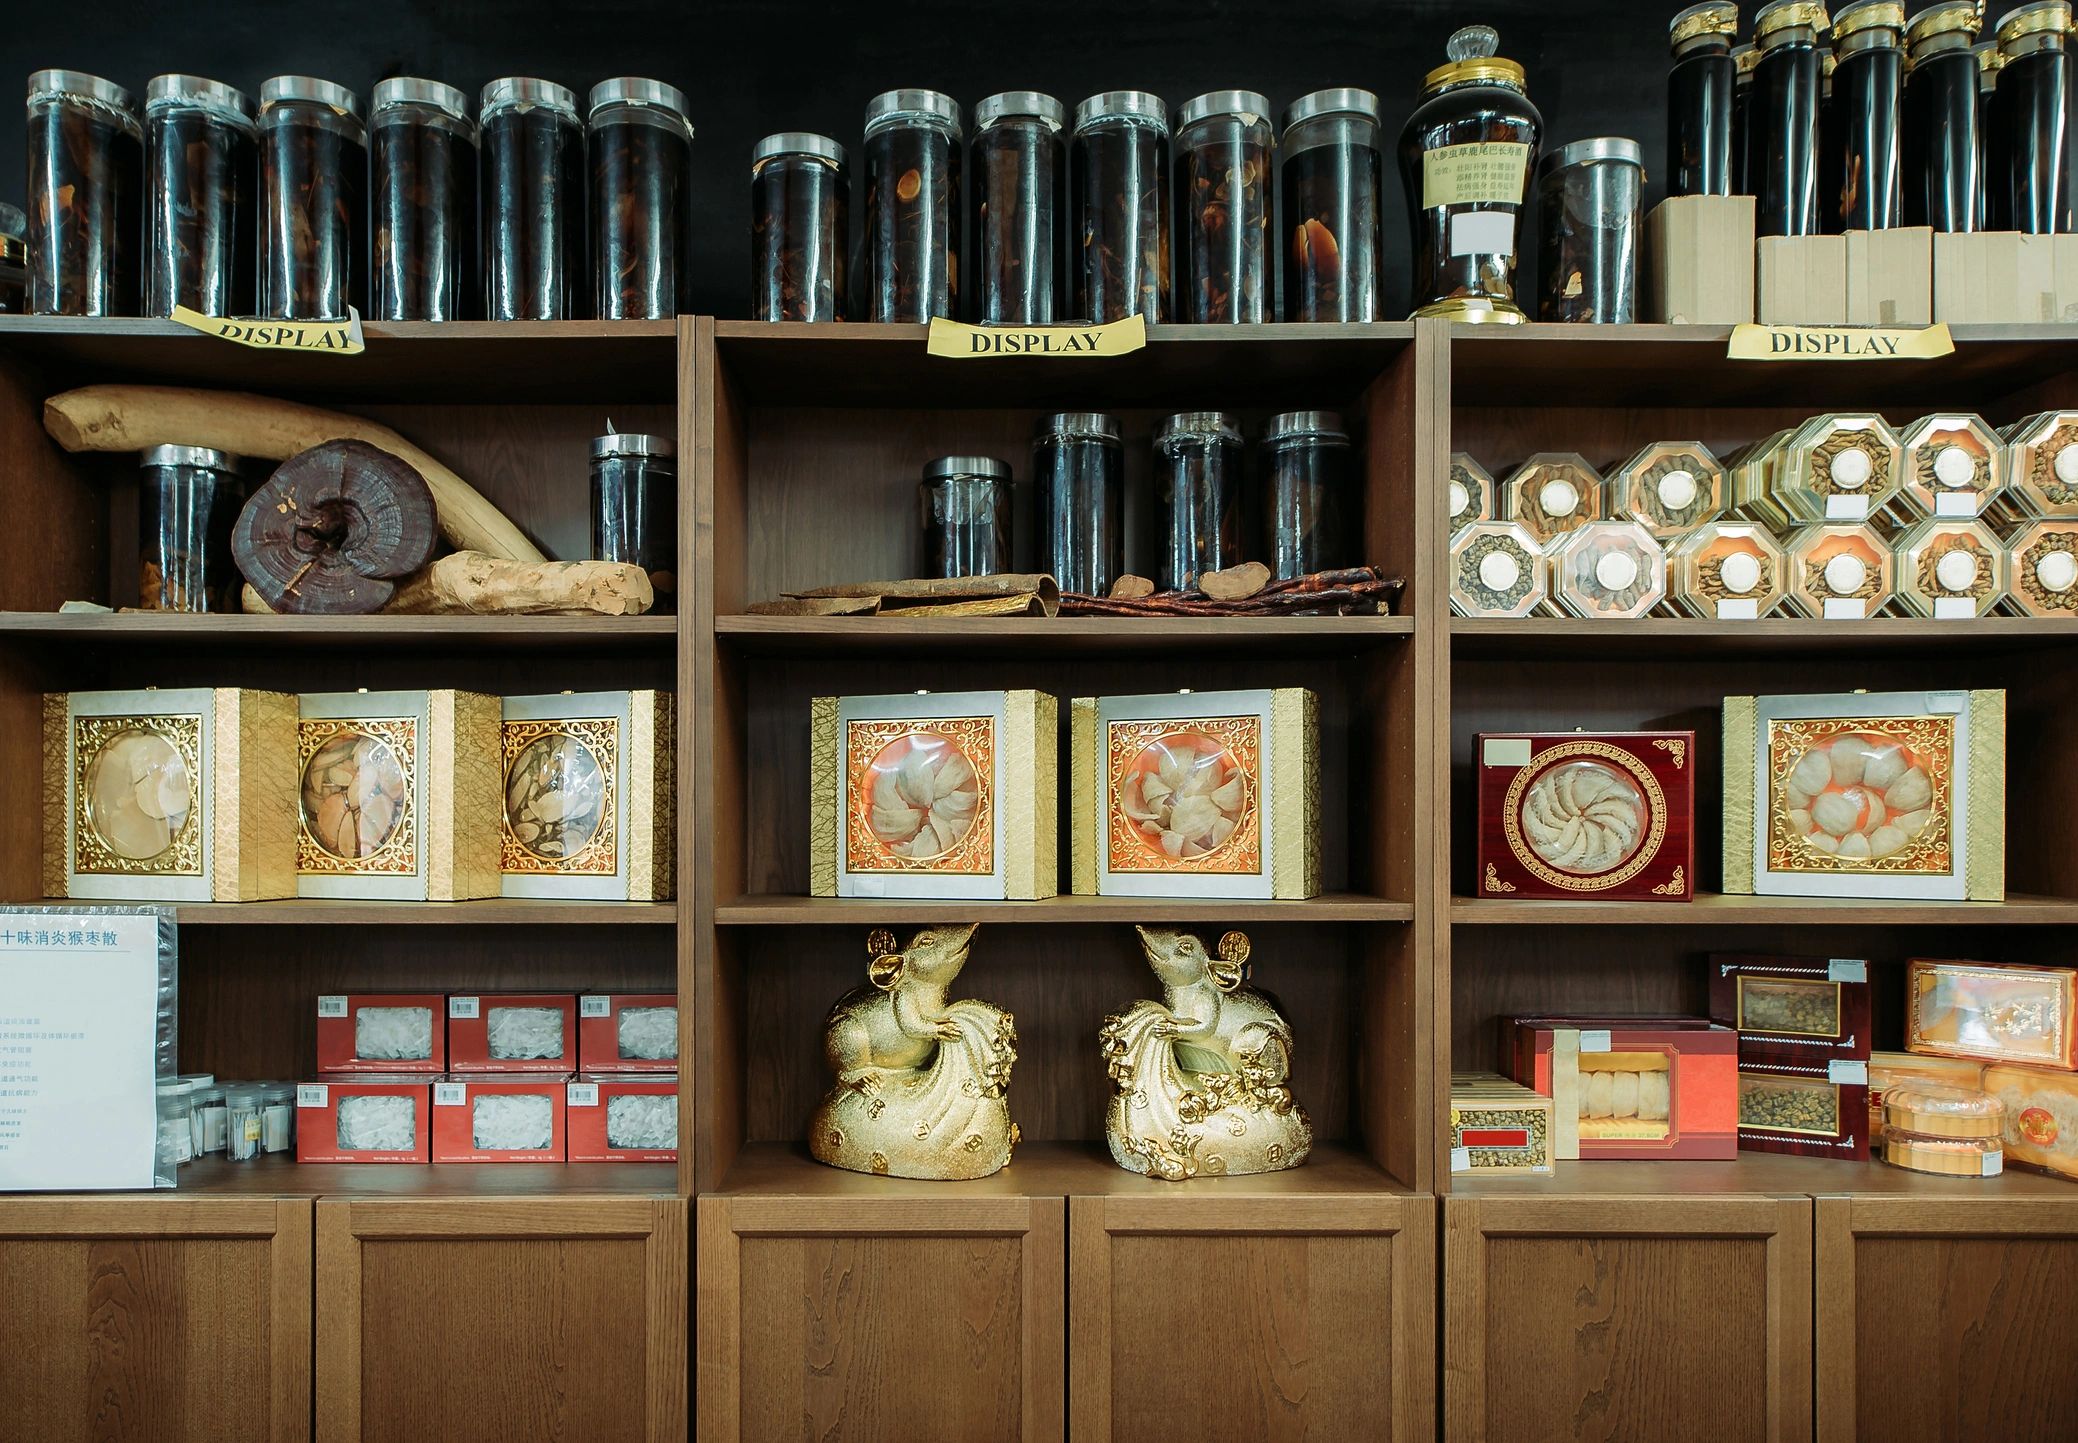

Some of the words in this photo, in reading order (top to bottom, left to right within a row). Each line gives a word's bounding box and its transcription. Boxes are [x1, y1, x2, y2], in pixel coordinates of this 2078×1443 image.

[1431, 145, 1522, 161] 人参虫草鹿尾巴长寿酒
[218, 324, 350, 349] DISPLAY
[970, 332, 1102, 353] DISPLAY
[1770, 332, 1900, 355] DISPLAY
[0, 930, 118, 946] 十味消炎猴枣散
